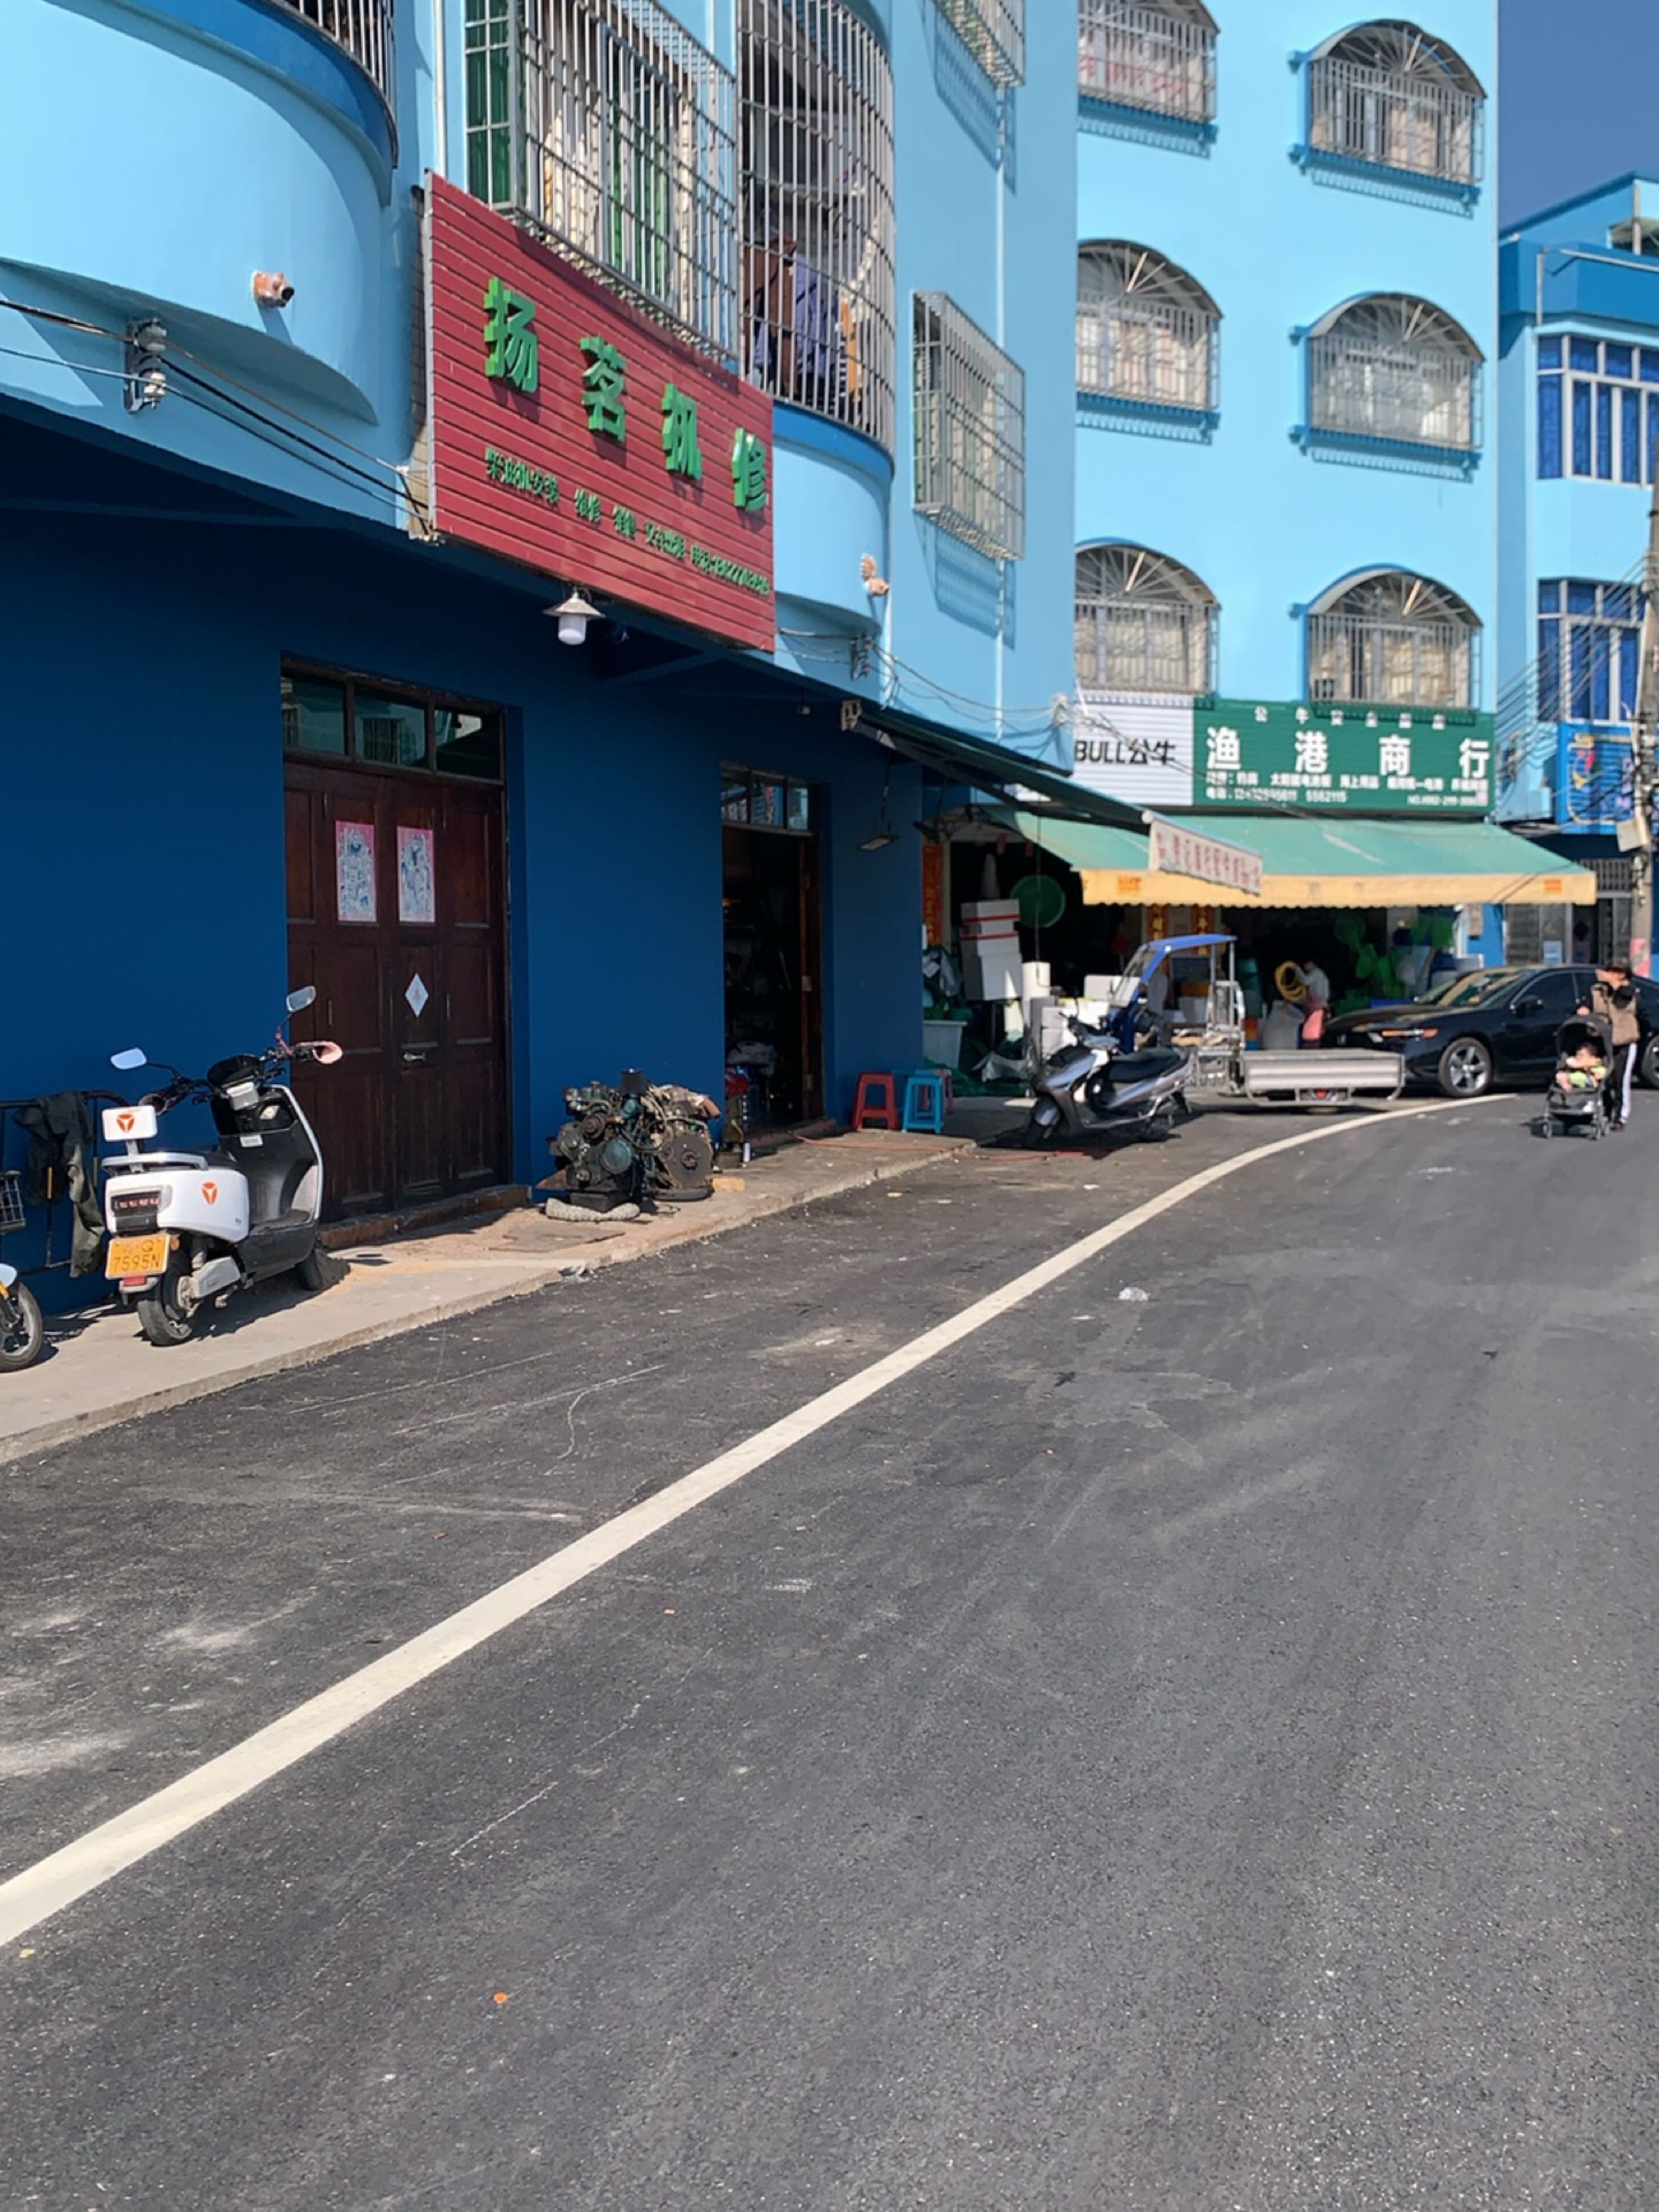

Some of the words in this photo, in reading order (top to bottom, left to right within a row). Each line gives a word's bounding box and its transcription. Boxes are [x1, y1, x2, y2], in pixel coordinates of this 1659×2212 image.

[1206, 725, 1490, 779] 渔港商行
[112, 1253, 161, 1272] 7595N
